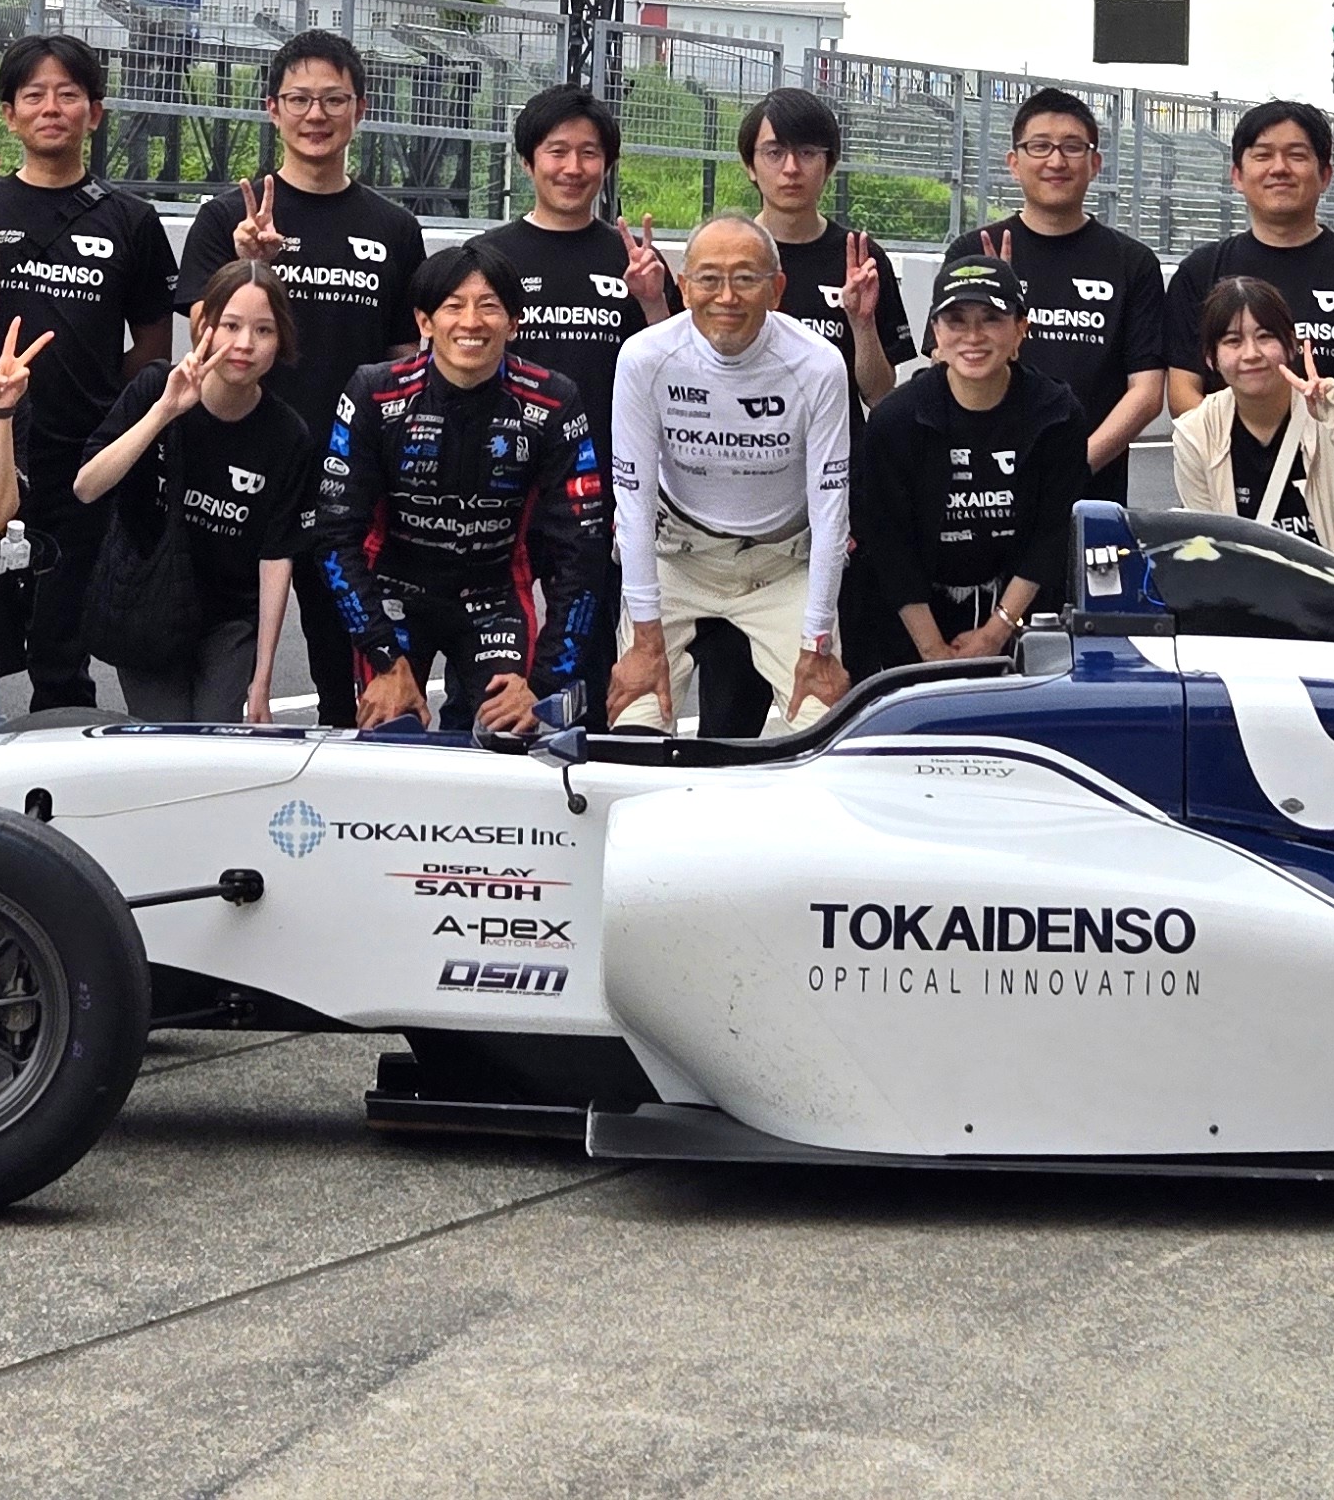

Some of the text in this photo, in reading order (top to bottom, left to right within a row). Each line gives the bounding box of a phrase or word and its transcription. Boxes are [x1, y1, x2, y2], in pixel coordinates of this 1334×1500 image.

[313, 290, 380, 307] INNOVATION
[518, 305, 622, 327] OKAIDENSO
[1027, 306, 1105, 329] AIDENSO
[519, 330, 551, 340] TICAL
[664, 426, 791, 448] TOKAIDENSO
[914, 763, 1015, 779] Dr. Dry
[531, 828, 576, 848] Inc.
[422, 862, 537, 878] DISPLAY
[415, 880, 541, 902] SATOH
[432, 914, 573, 945] A-pex
[809, 902, 1197, 955] TOKAIDENSO
[485, 938, 578, 951] MOTOR SPORT
[809, 965, 1201, 997] OPTICAL INNOVATION
